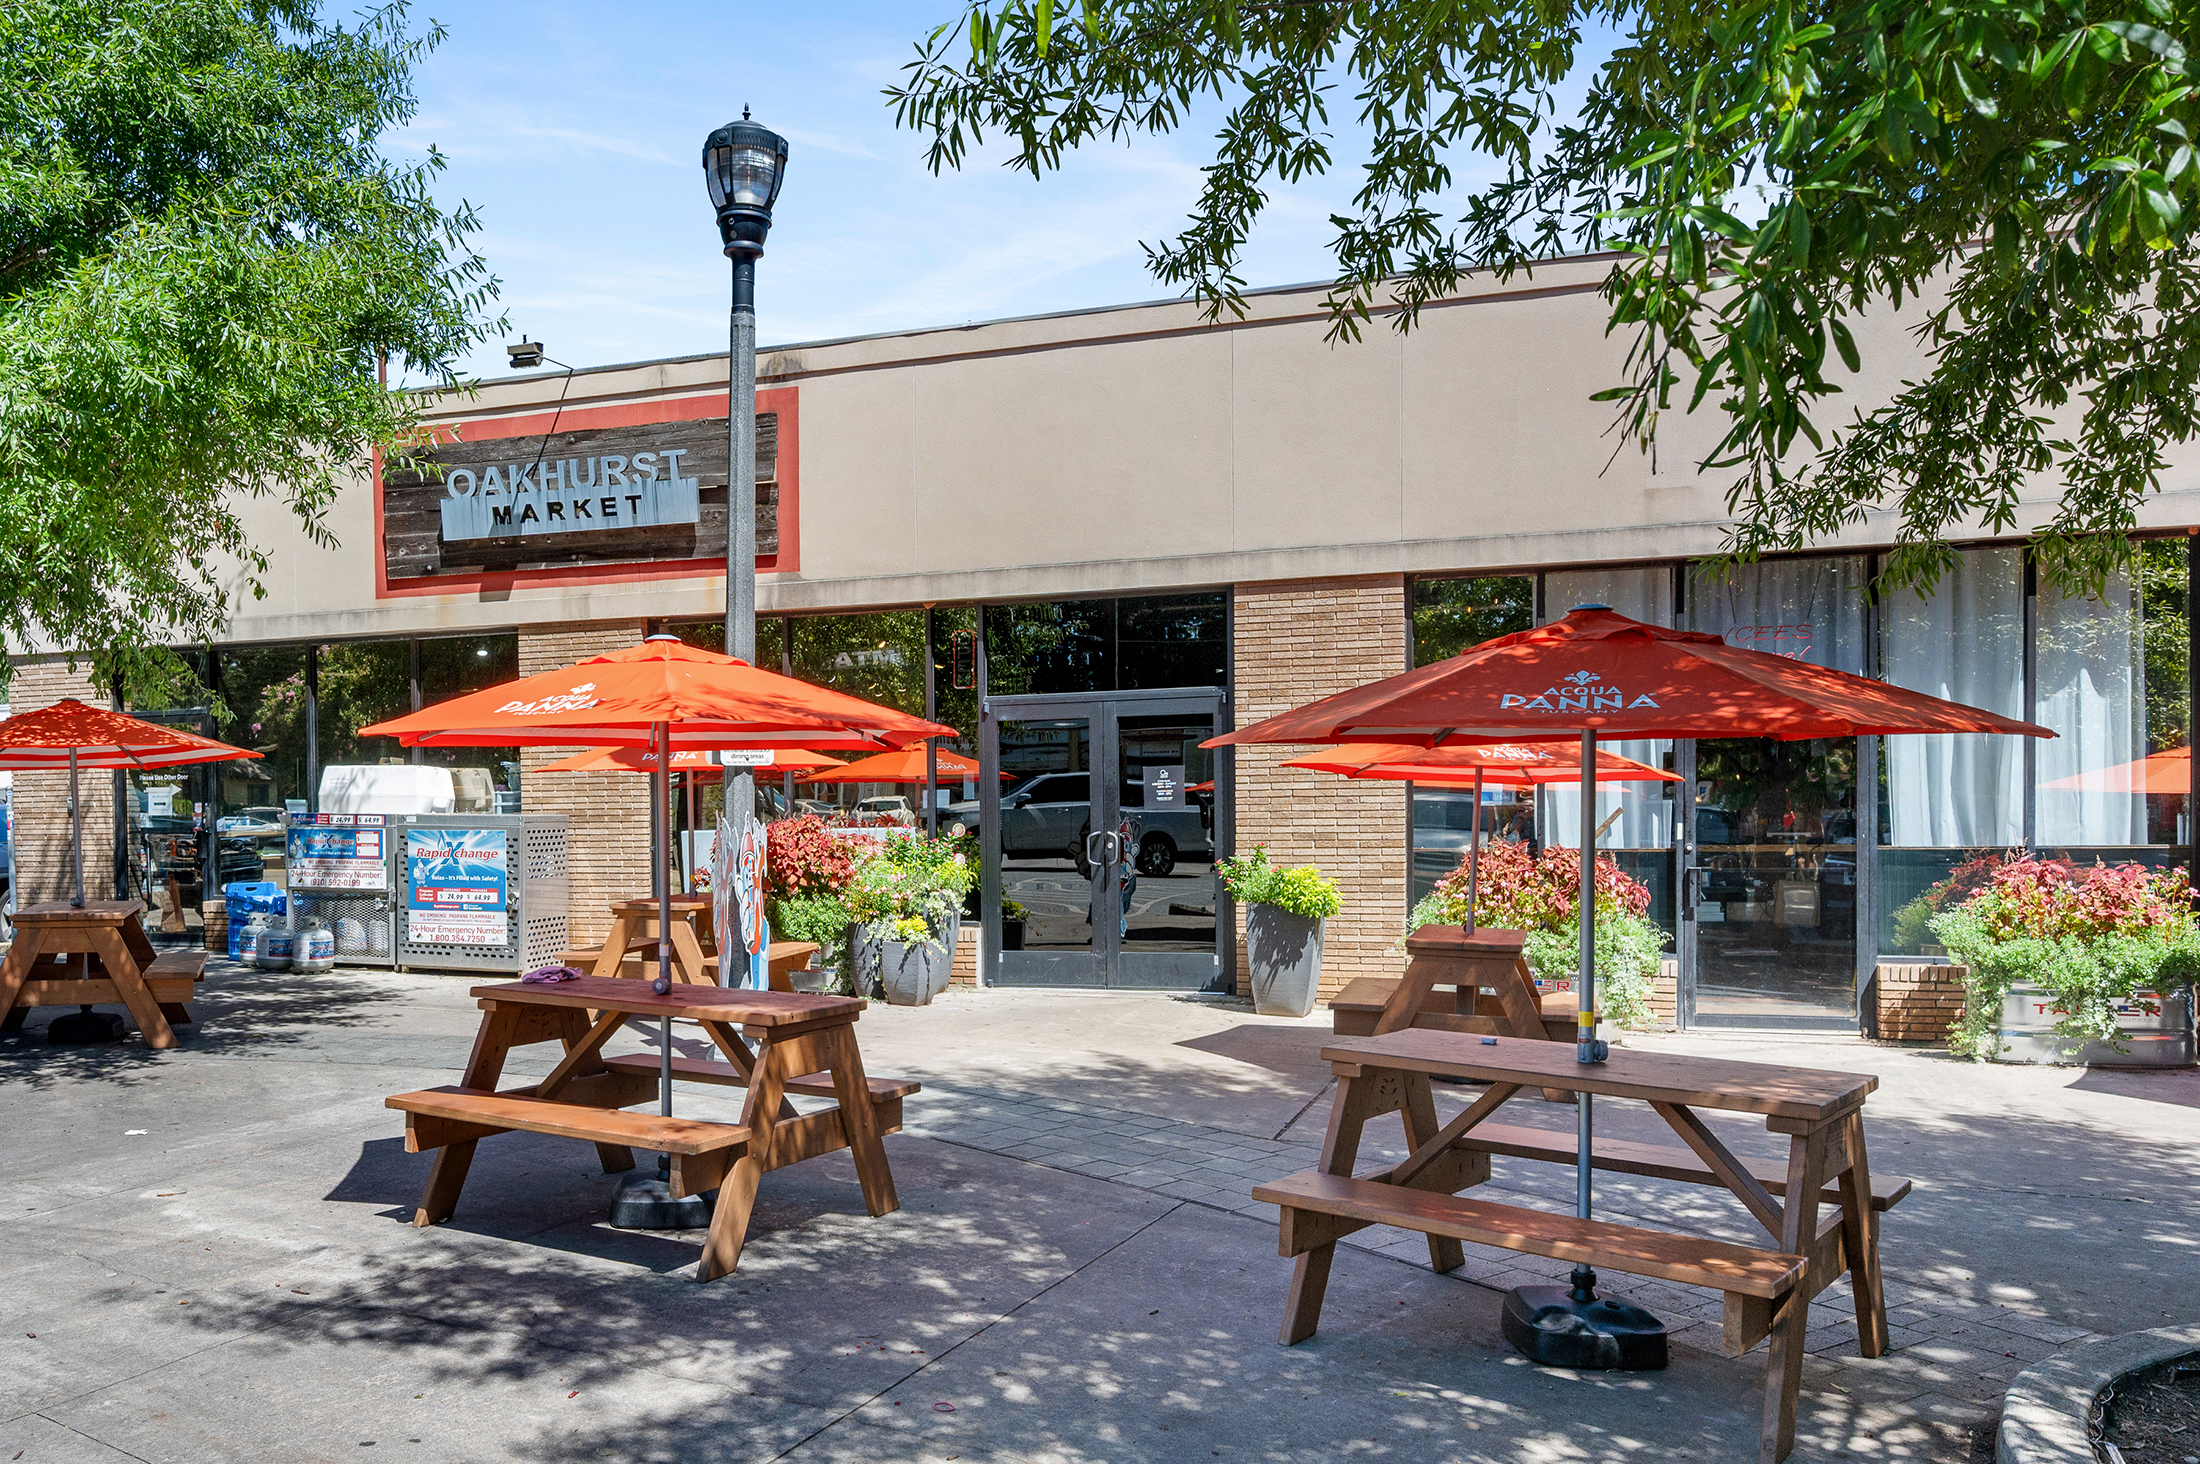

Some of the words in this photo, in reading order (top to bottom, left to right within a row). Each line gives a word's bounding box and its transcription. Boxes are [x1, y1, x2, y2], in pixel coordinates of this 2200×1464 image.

[447, 449, 687, 498] OAKHURST
[492, 495, 642, 525] MARKET
[834, 649, 897, 668] ATM
[1543, 686, 1622, 696] ACQUA
[493, 698, 599, 713] PANNA
[1500, 693, 1661, 709] PANNA
[1477, 749, 1554, 759] PANNA
[318, 871, 353, 879] Emergency
[438, 926, 475, 935] Emergency
[430, 934, 485, 943] 1.800.354.7250
